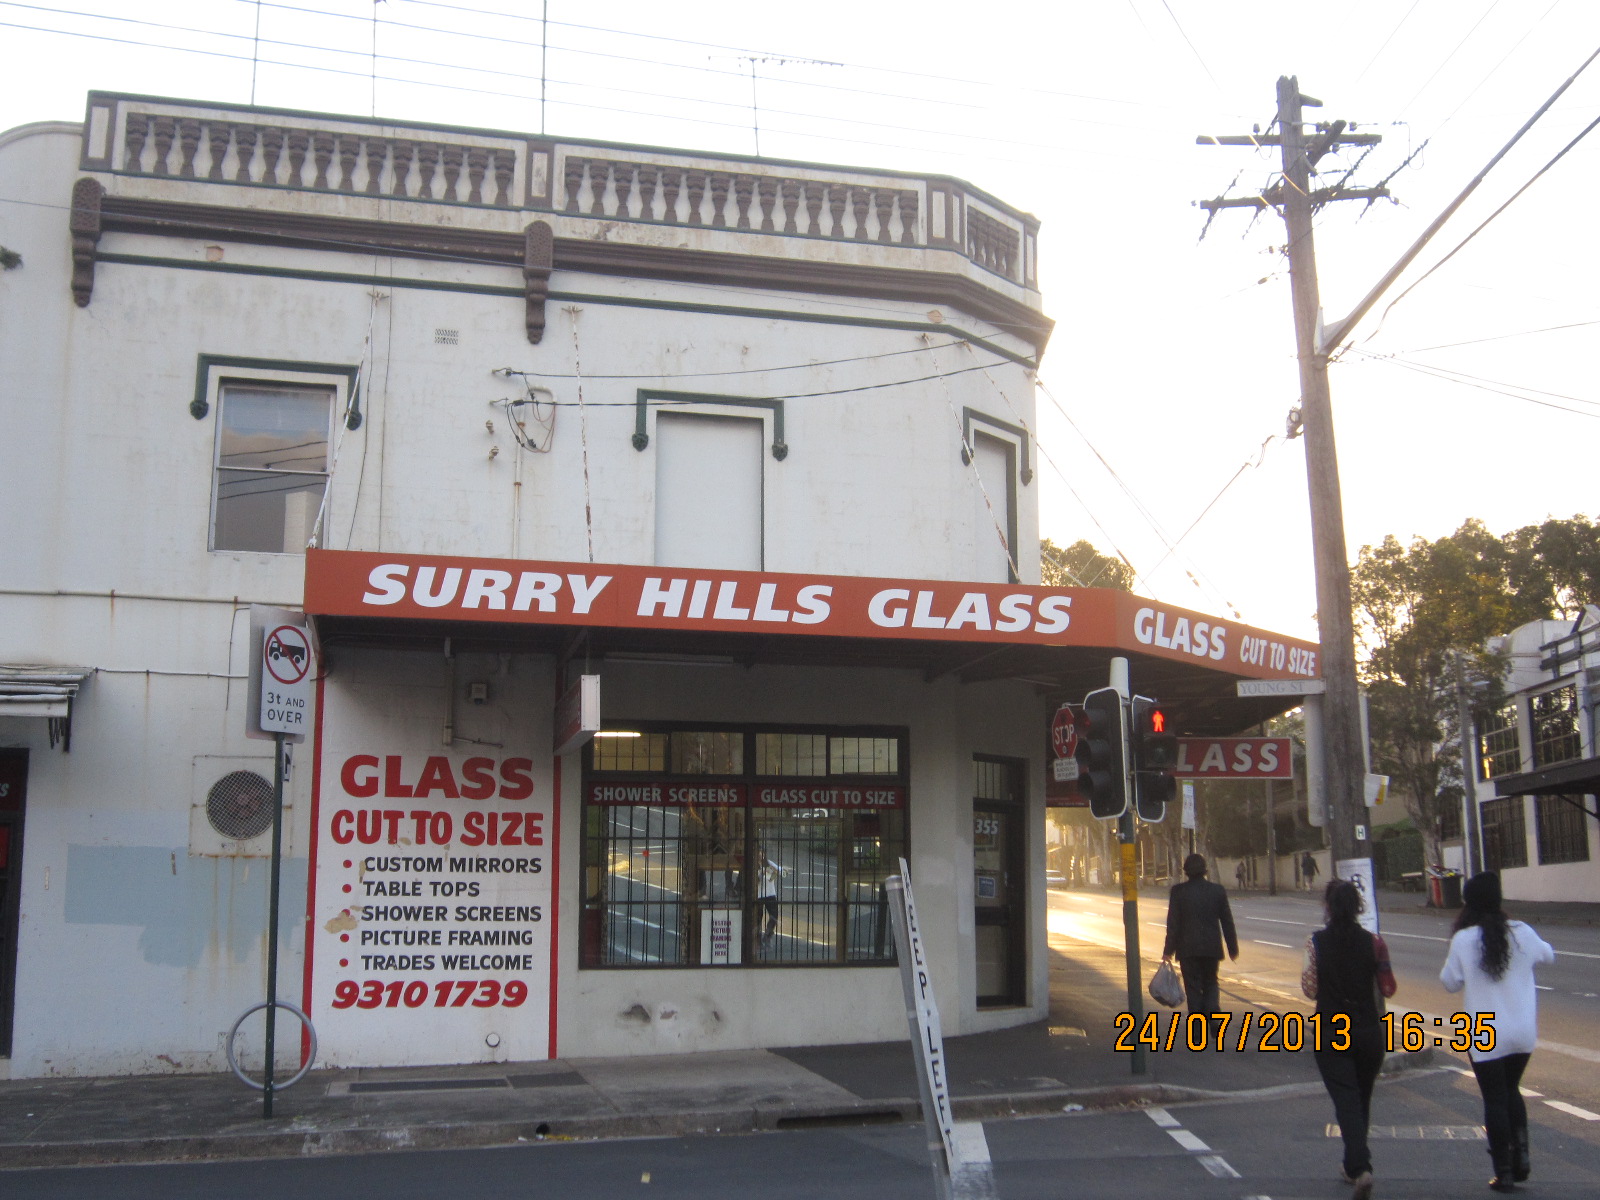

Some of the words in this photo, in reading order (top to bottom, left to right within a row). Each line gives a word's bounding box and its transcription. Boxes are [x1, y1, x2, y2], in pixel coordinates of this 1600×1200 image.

[362, 563, 614, 614] SURRY
[636, 577, 834, 625] HILLS
[867, 588, 1072, 634] GLASS
[1133, 607, 1226, 661] GLASS
[1239, 635, 1268, 667] CUT
[1270, 642, 1286, 671] TO
[1287, 646, 1316, 677] SIZE
[1240, 682, 1286, 695] YOUNG
[1290, 681, 1305, 693] ST
[266, 692, 282, 705] 3t
[285, 697, 305, 708] AND
[267, 708, 303, 724] OVER
[1054, 723, 1075, 745] STOP
[1176, 742, 1279, 773] LASS
[340, 754, 534, 800] GLASS
[593, 786, 662, 802] SHOWER
[668, 788, 738, 803] SCREENS
[760, 789, 807, 804] GLASS
[810, 790, 838, 804] CUT
[842, 790, 861, 804] TO
[865, 791, 896, 805] SIZE
[330, 809, 405, 845] CUT
[410, 810, 453, 845] TO
[459, 811, 544, 846] SIZE
[975, 819, 999, 835] 355
[363, 856, 443, 873] CUSTOM
[449, 857, 542, 874] MIRRORS
[362, 880, 423, 897] TABLE
[429, 881, 480, 897] TOPS
[360, 905, 448, 922] SHOWER
[454, 906, 542, 922] SCREENS
[360, 930, 442, 946] PICTURE
[448, 930, 533, 946] FRAMING
[360, 954, 436, 971] TRADES
[441, 954, 533, 971] WELCOME
[331, 979, 429, 1009] 9310
[433, 979, 529, 1009] 1739
